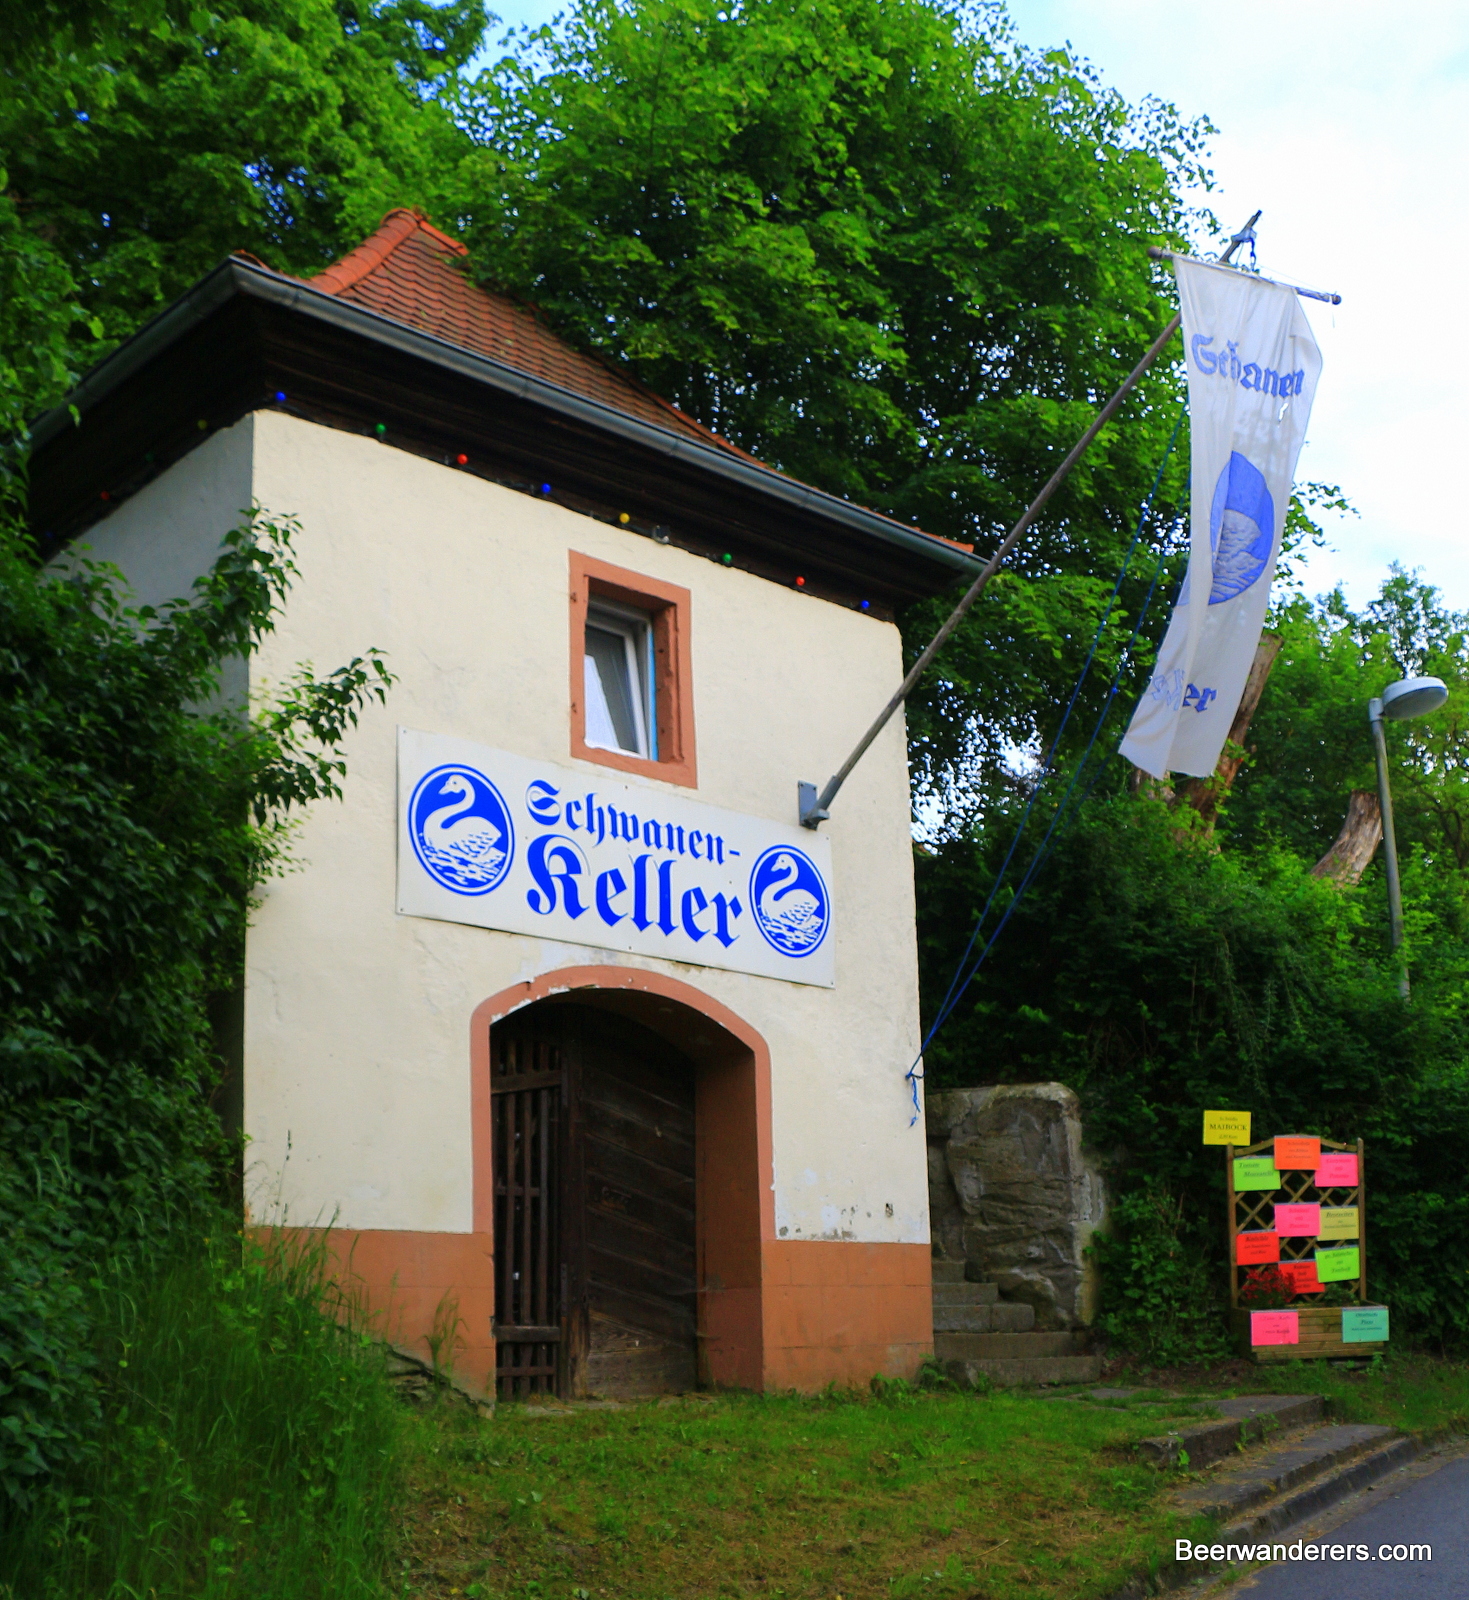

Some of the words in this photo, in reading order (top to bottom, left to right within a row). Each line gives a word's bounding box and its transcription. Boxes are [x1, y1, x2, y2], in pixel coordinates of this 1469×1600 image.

[525, 779, 740, 866] Schwanen-
[526, 833, 744, 949] Keller
[1209, 1123, 1247, 1131] MAIBOCK
